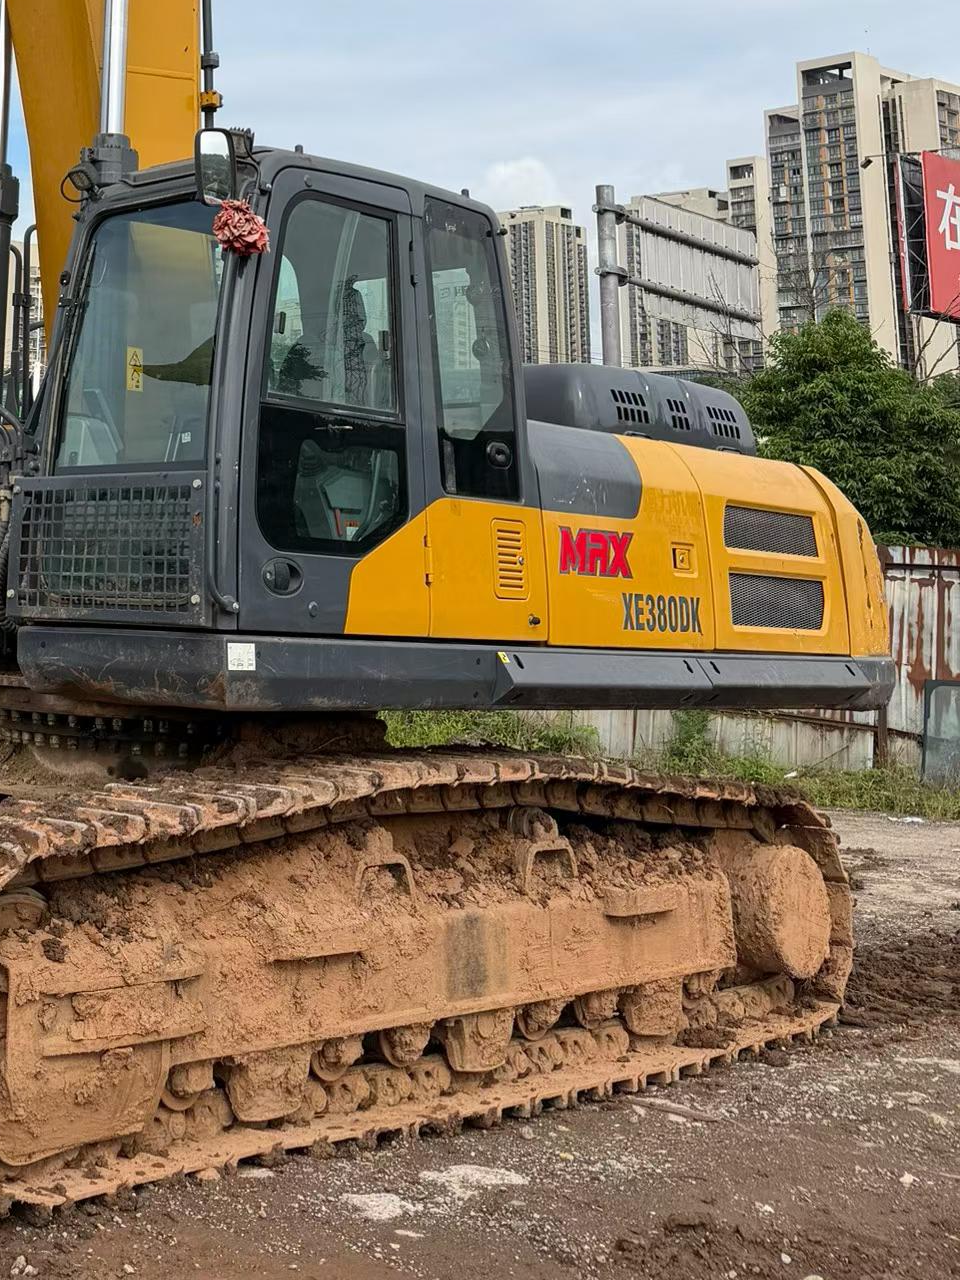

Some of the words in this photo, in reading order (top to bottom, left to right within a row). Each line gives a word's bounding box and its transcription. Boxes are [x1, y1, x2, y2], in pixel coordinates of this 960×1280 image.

[936, 183, 960, 251] 在
[558, 525, 635, 580] MAX
[622, 592, 702, 634] XE380DK
